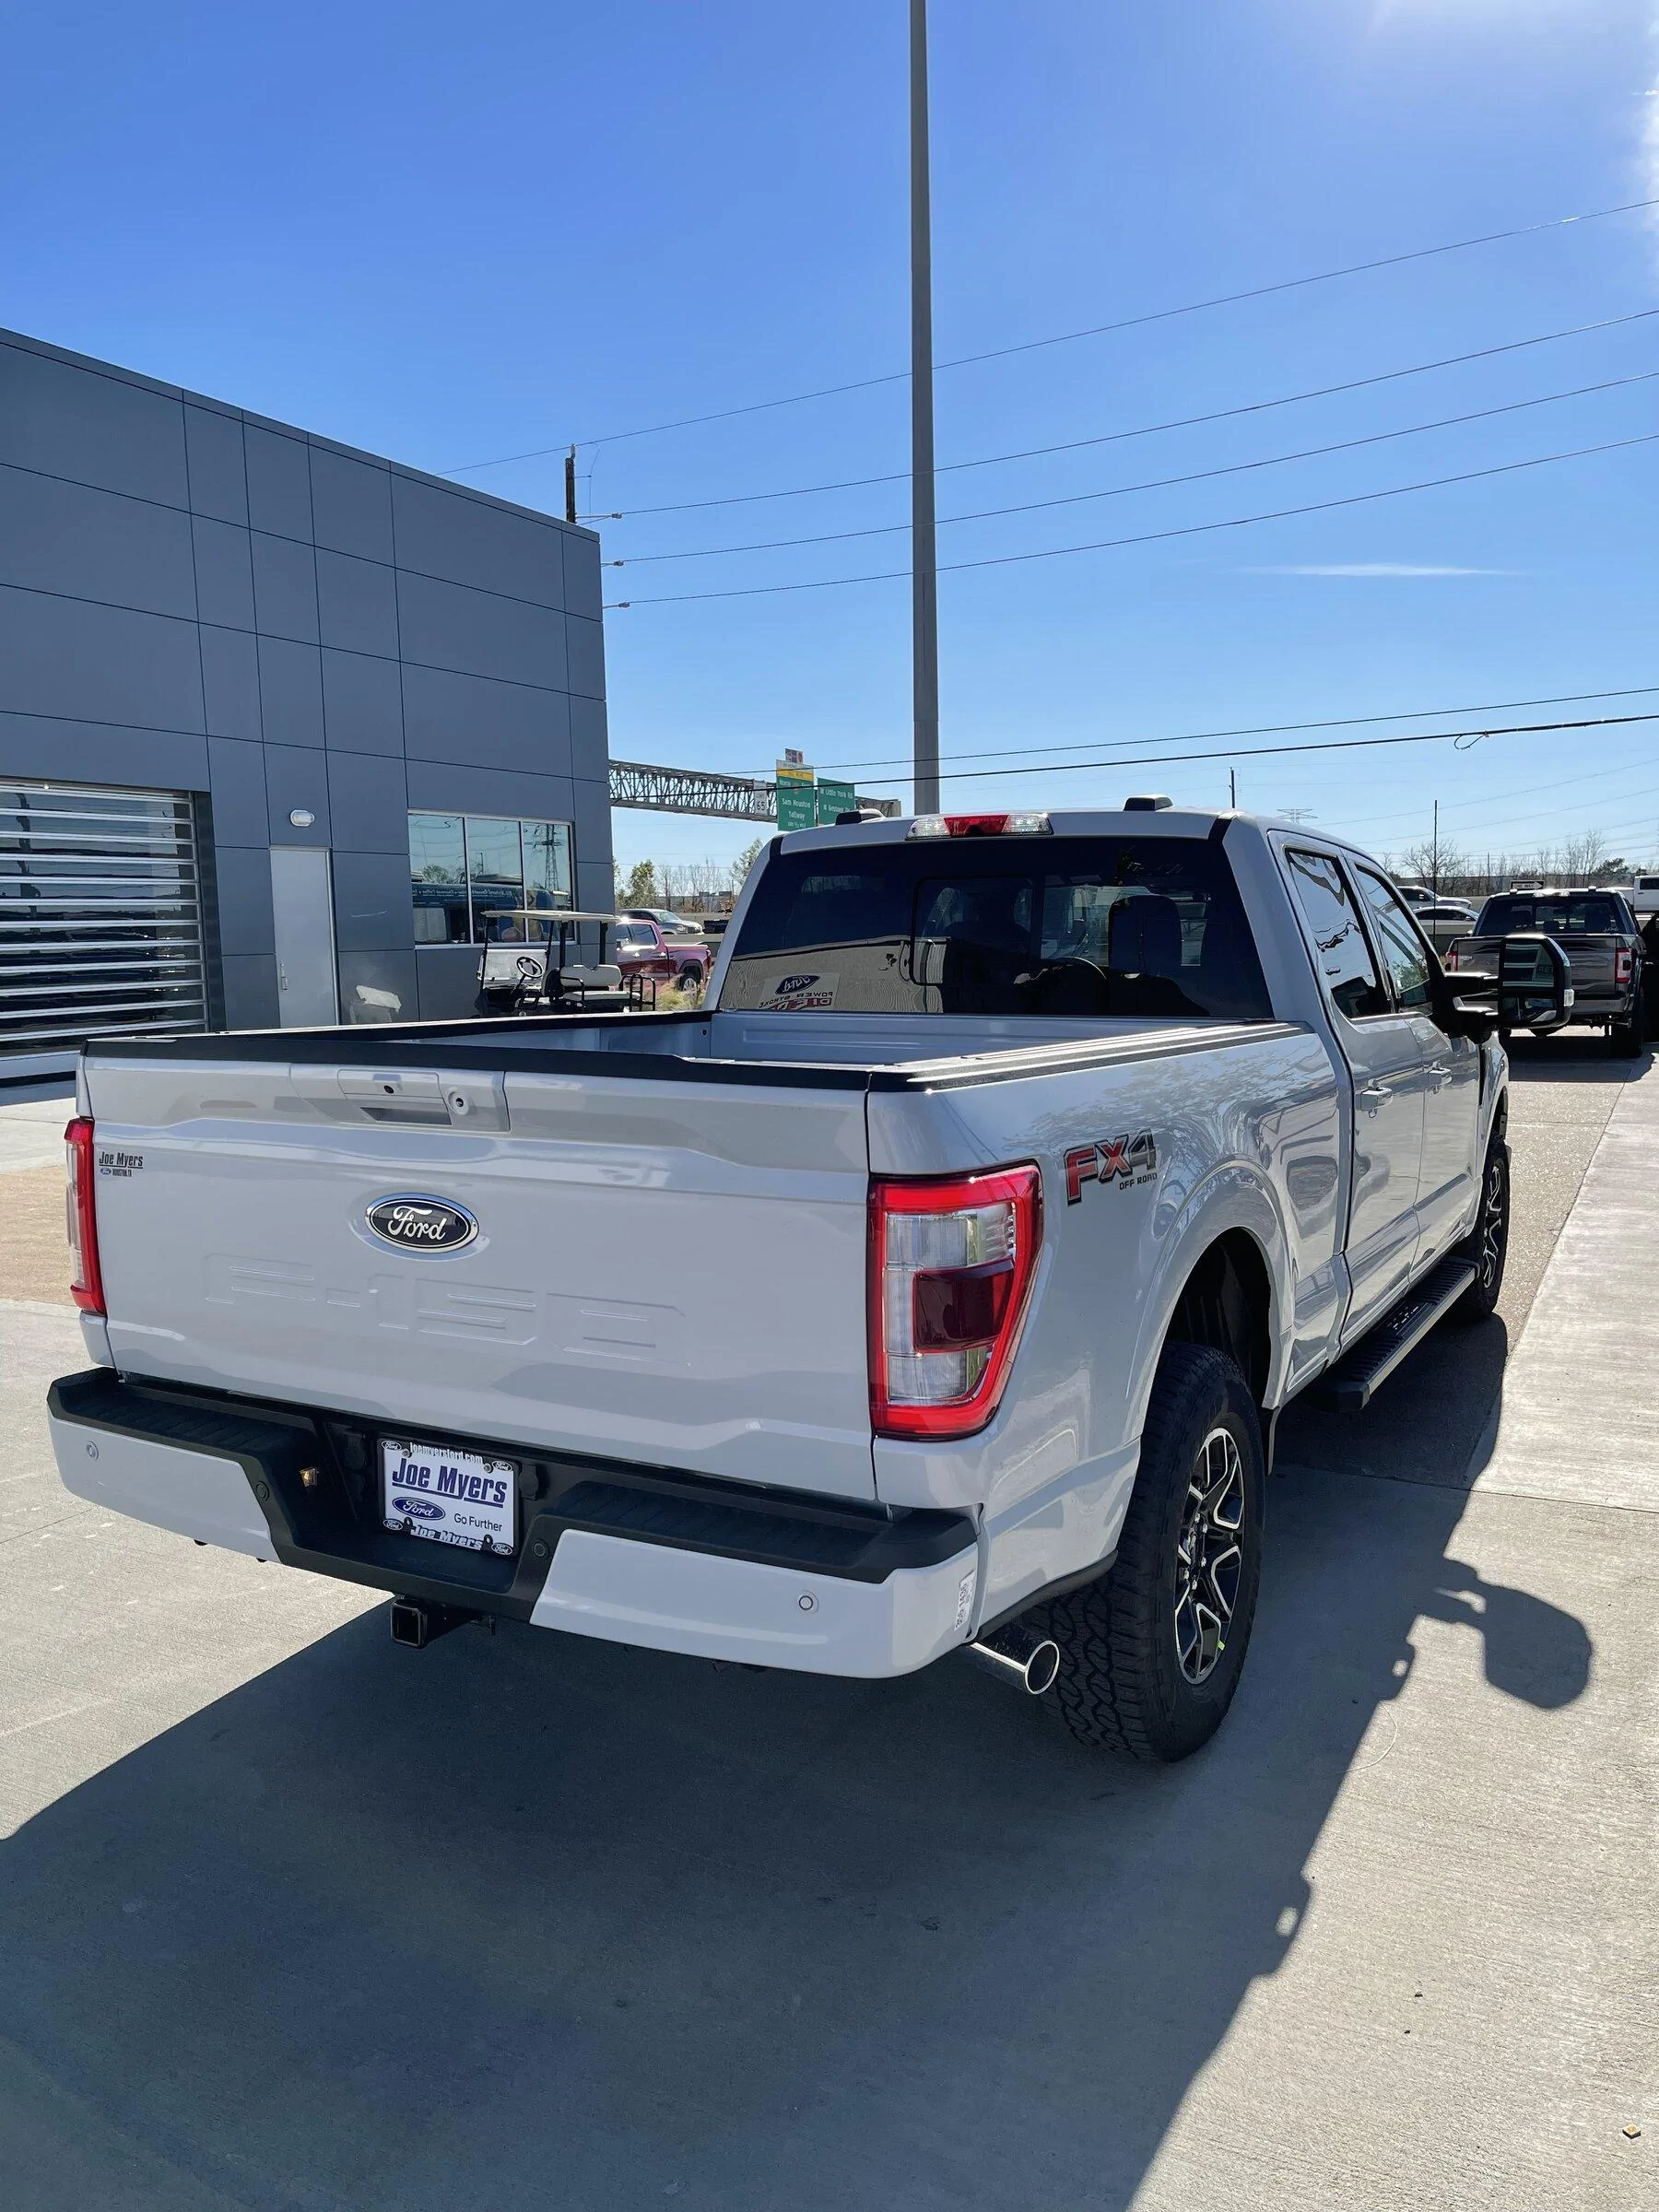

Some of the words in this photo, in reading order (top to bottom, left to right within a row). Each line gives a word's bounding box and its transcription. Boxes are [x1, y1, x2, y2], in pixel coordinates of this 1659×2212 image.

[782, 797, 792, 806] Sam
[793, 800, 811, 808] Houston
[837, 790, 847, 798] York
[757, 801, 765, 811] 65
[788, 811, 806, 822] Tollway
[99, 1151, 114, 1165] Joe
[116, 1152, 144, 1168] Myers
[1064, 1127, 1157, 1206] FX4
[1119, 1179, 1135, 1190] OFF
[1136, 1171, 1158, 1185] ROAD
[387, 1205, 446, 1241] Ford
[392, 1458, 430, 1488] Joe
[437, 1465, 508, 1505] Myers
[403, 1500, 434, 1518] Ford
[453, 1512, 467, 1525] Go
[469, 1517, 503, 1533] Further
[410, 1524, 435, 1541] Joe
[440, 1532, 484, 1550] Myers
